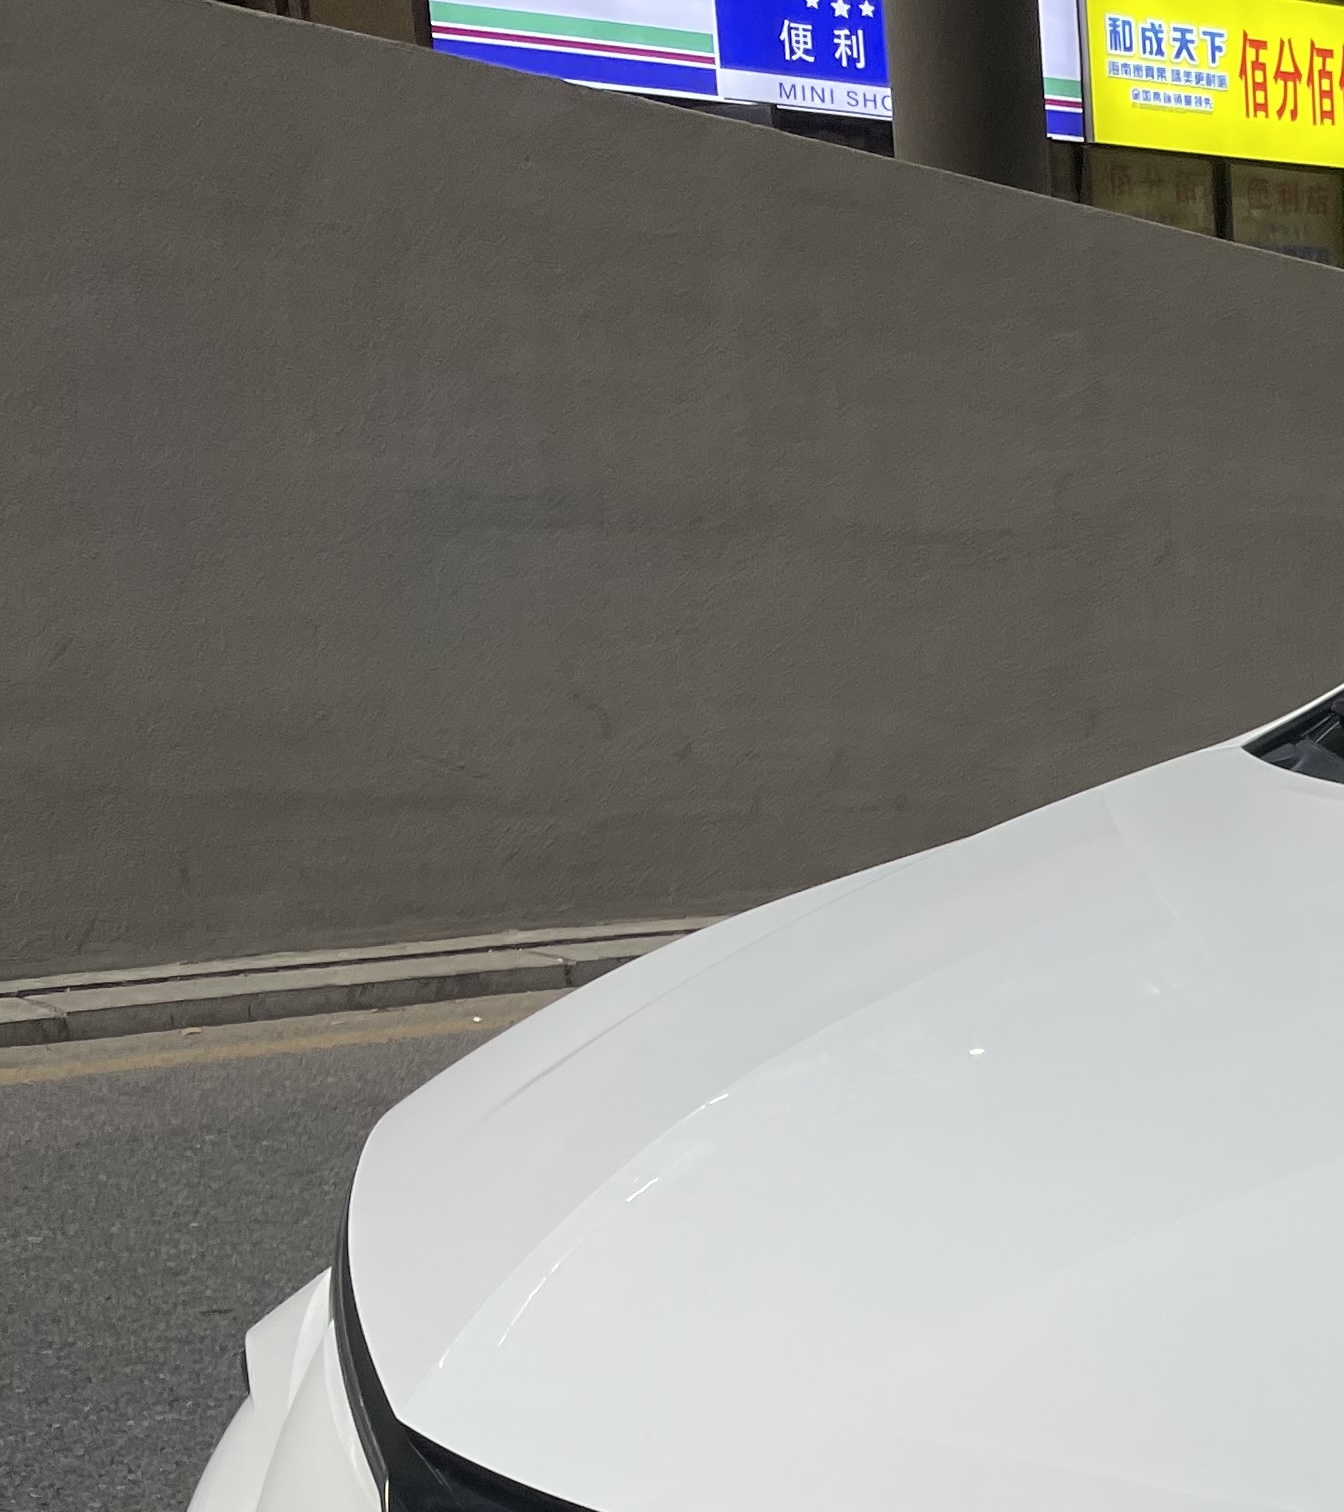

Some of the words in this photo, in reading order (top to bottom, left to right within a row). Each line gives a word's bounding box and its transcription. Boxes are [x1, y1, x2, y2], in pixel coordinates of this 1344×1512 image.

[779, 19, 867, 70] 便利
[1108, 17, 1226, 64] 和成天下
[779, 83, 834, 105] MINI
